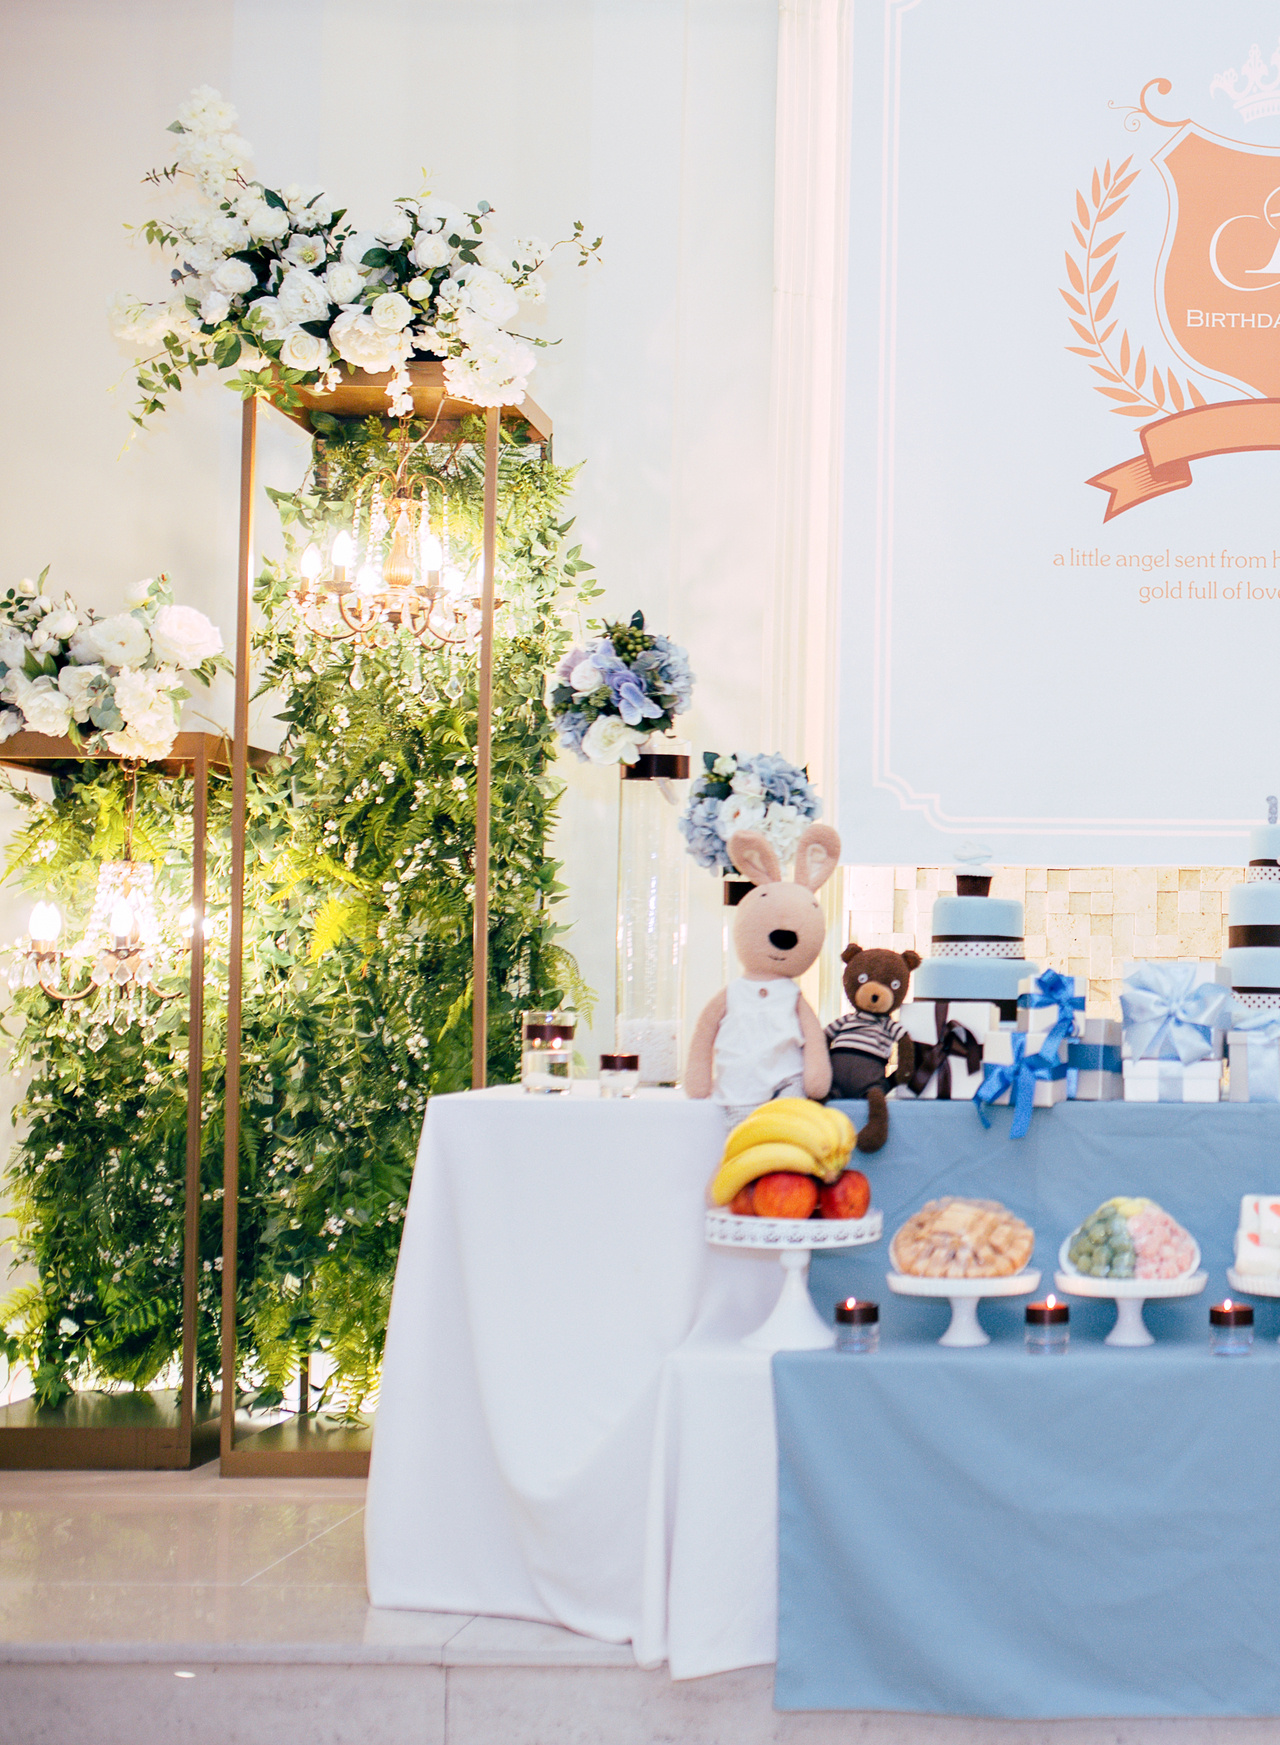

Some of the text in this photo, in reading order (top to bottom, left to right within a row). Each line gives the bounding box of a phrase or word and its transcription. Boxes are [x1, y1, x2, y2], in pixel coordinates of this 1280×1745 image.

[1053, 554, 1066, 567] a
[1069, 547, 1112, 567] little
[1115, 549, 1170, 573] angel
[1174, 552, 1216, 569] sent
[1220, 549, 1267, 569] from
[1138, 581, 1183, 604] gold
[1187, 581, 1218, 600] full
[1222, 581, 1244, 601] of
